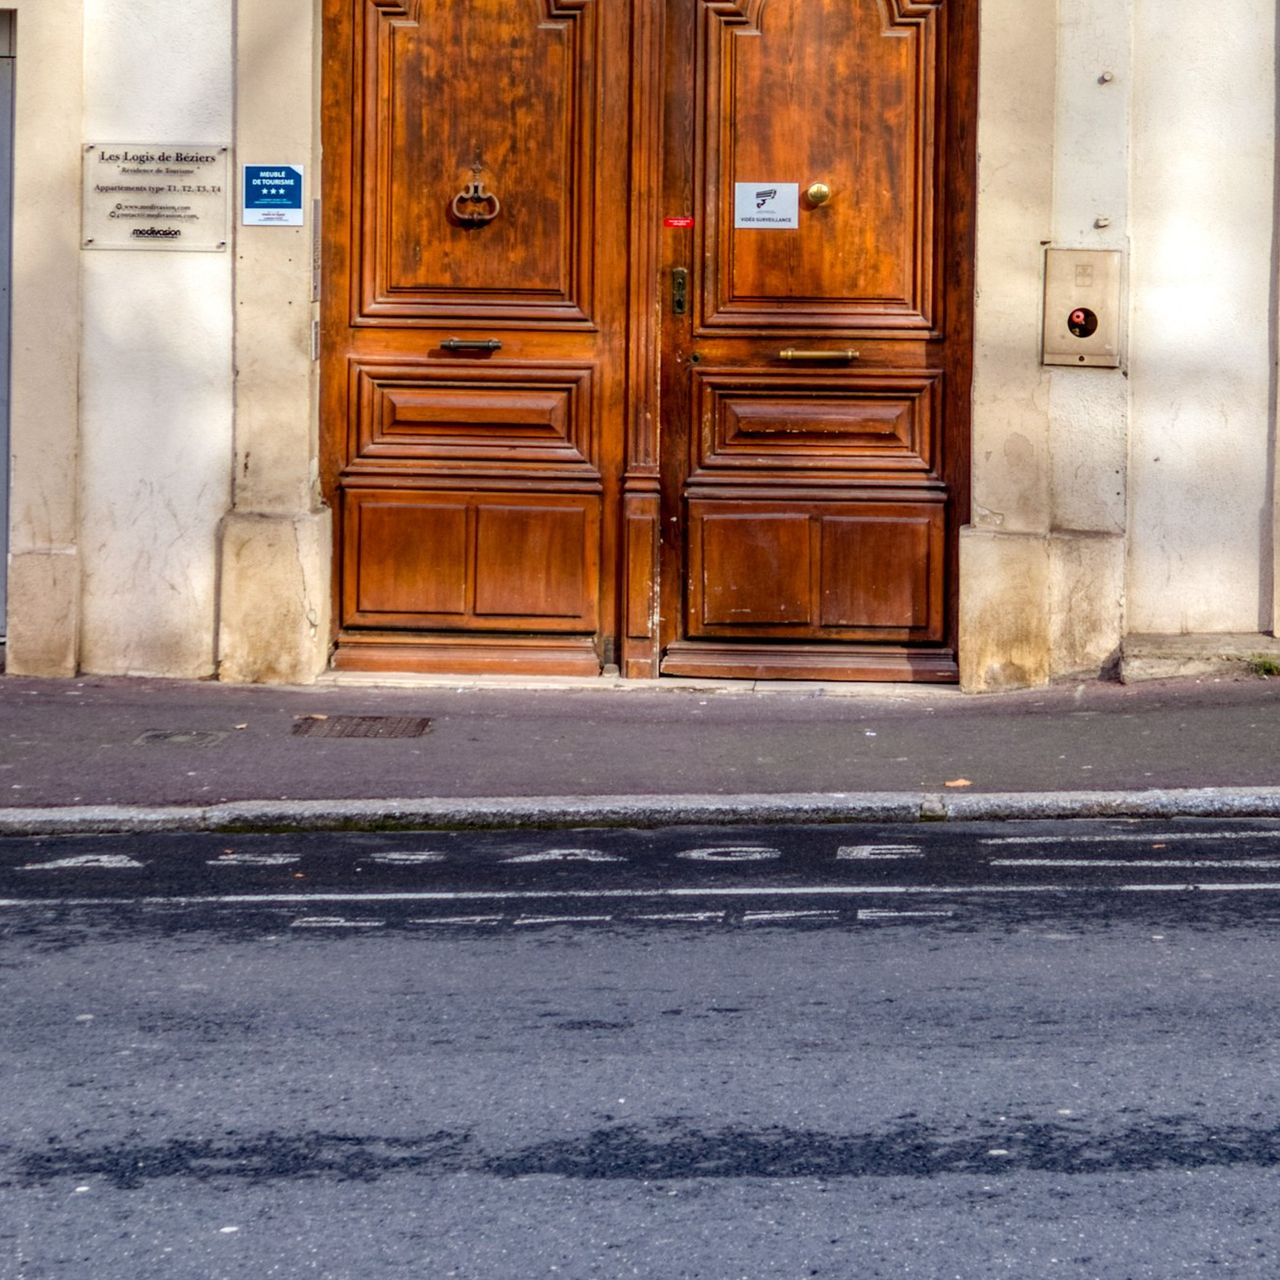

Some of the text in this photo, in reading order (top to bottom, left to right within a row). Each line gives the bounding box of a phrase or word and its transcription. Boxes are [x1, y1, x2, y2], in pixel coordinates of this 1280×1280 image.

[101, 151, 216, 164] Les Logis de Béziers
[95, 184, 147, 193] Appartements
[148, 185, 165, 194] type
